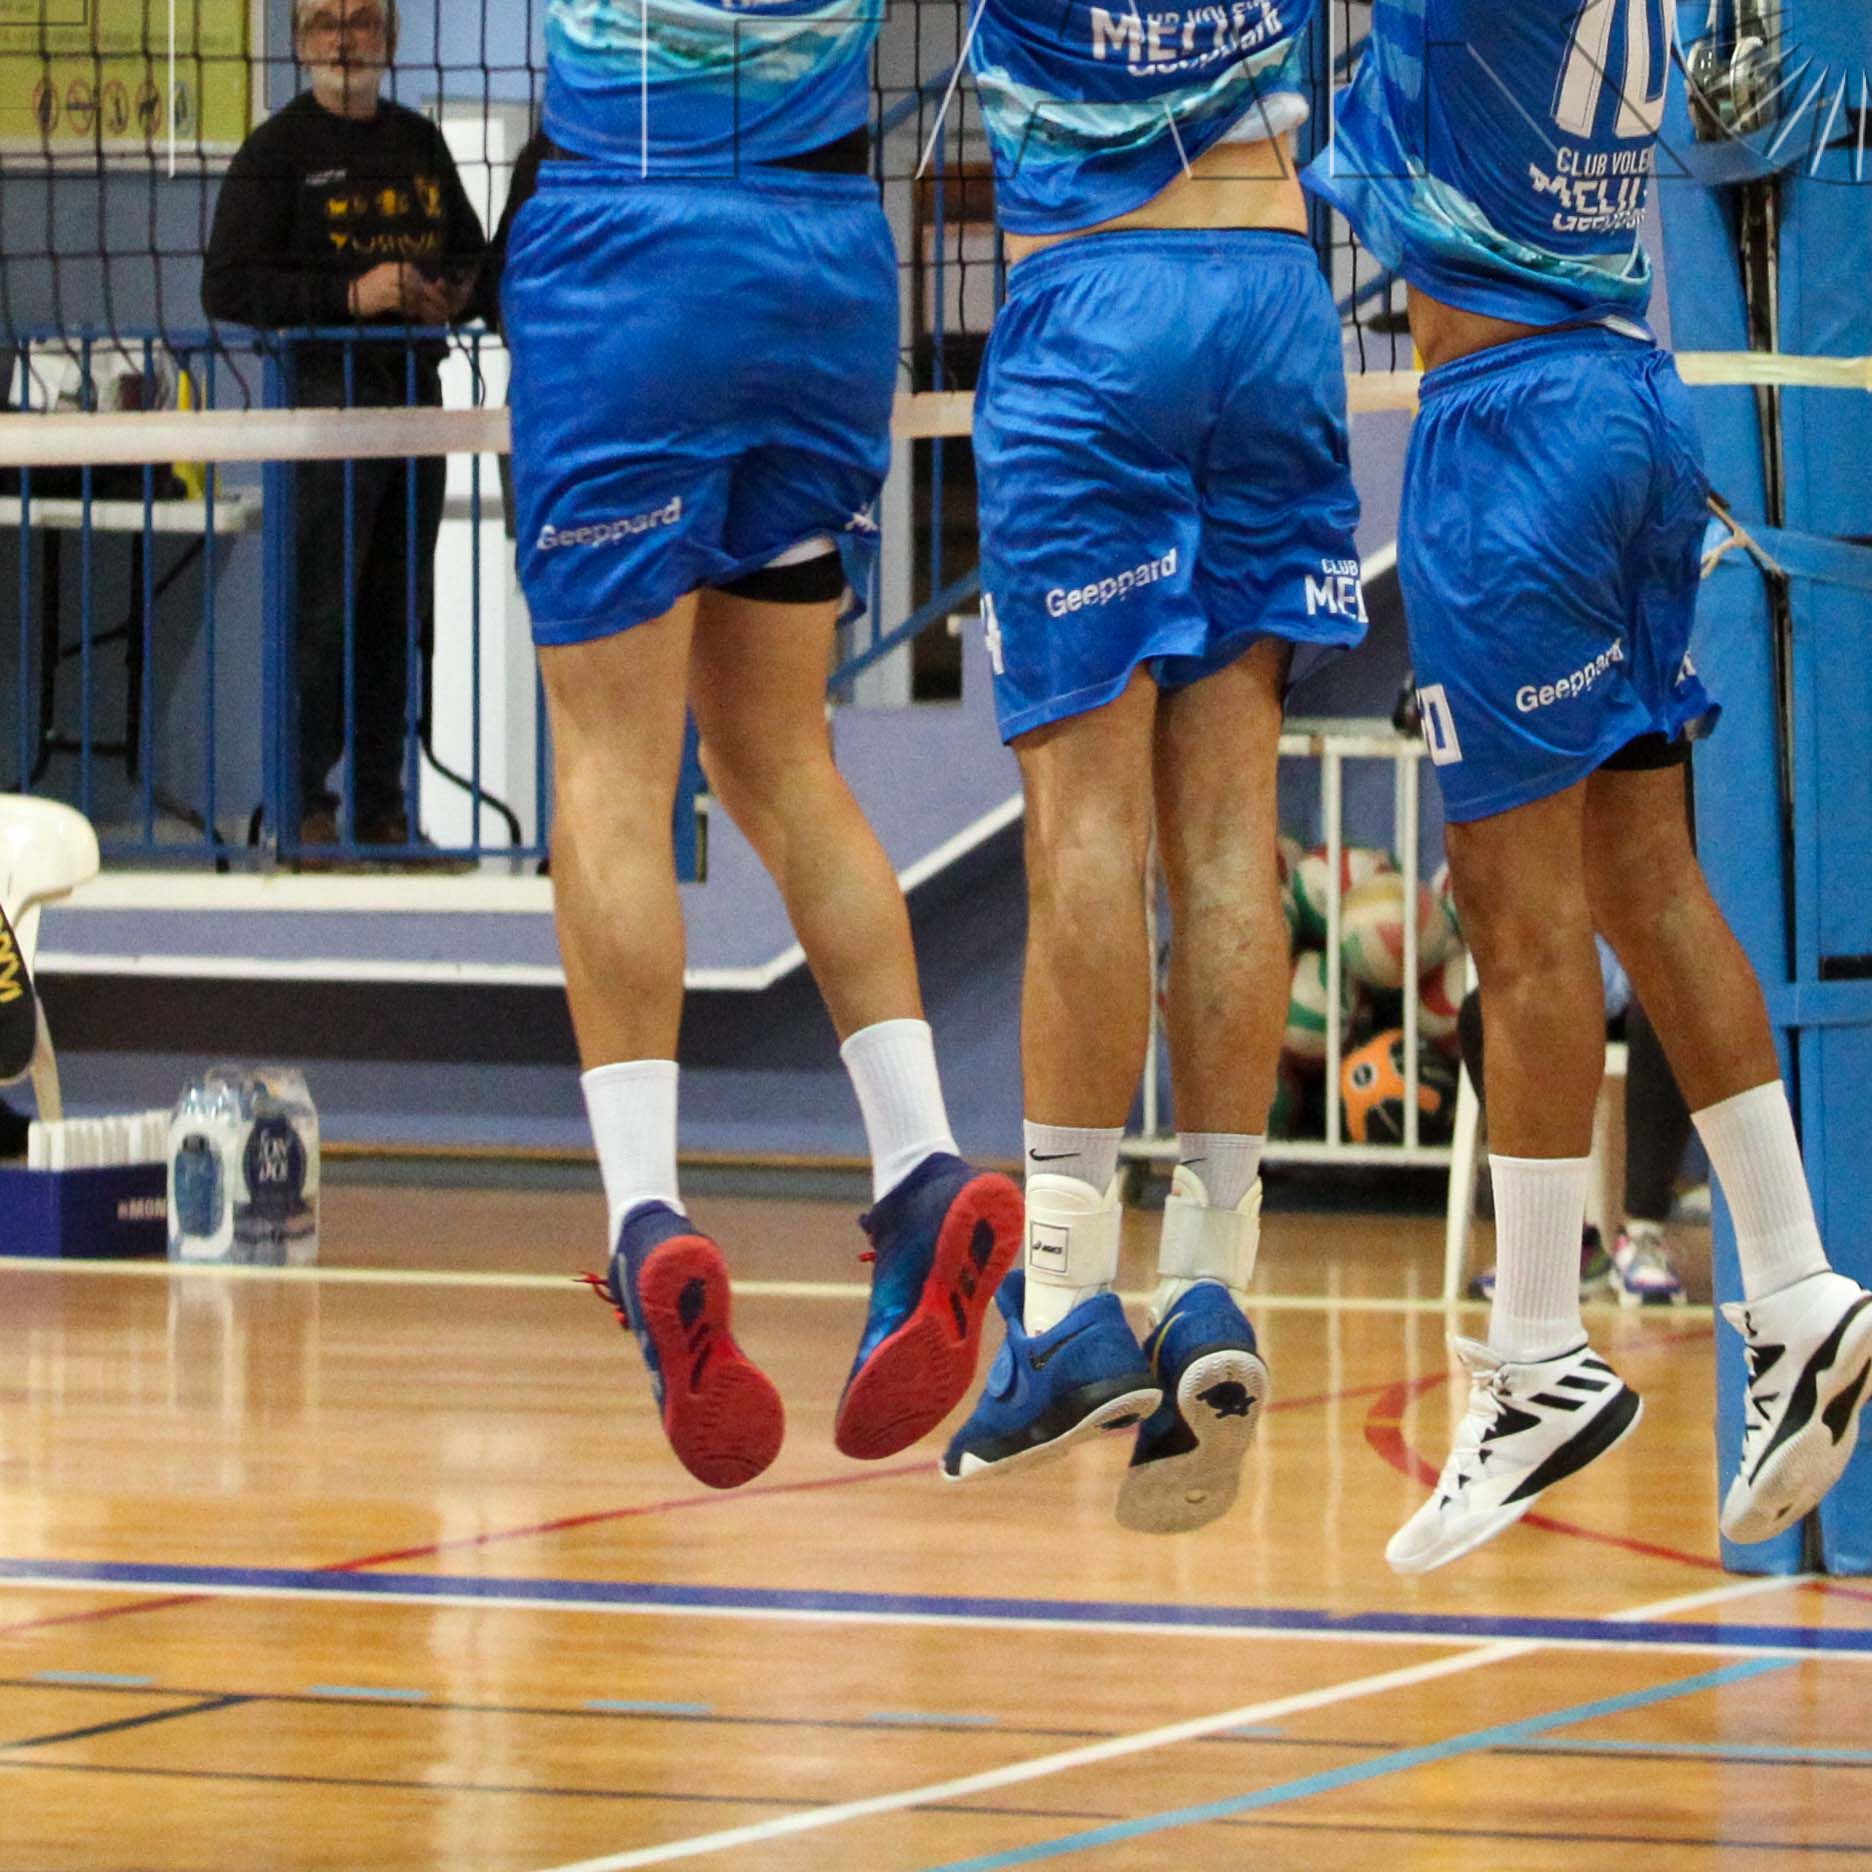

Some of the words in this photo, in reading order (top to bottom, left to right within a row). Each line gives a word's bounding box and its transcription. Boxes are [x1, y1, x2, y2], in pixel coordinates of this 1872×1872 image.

[1556, 145, 1608, 178] CLUB
[536, 496, 682, 552] Geeppard
[1045, 548, 1178, 619] Geeppard
[1320, 557, 1359, 577] CLUB
[1515, 637, 1625, 713] Geeppard
